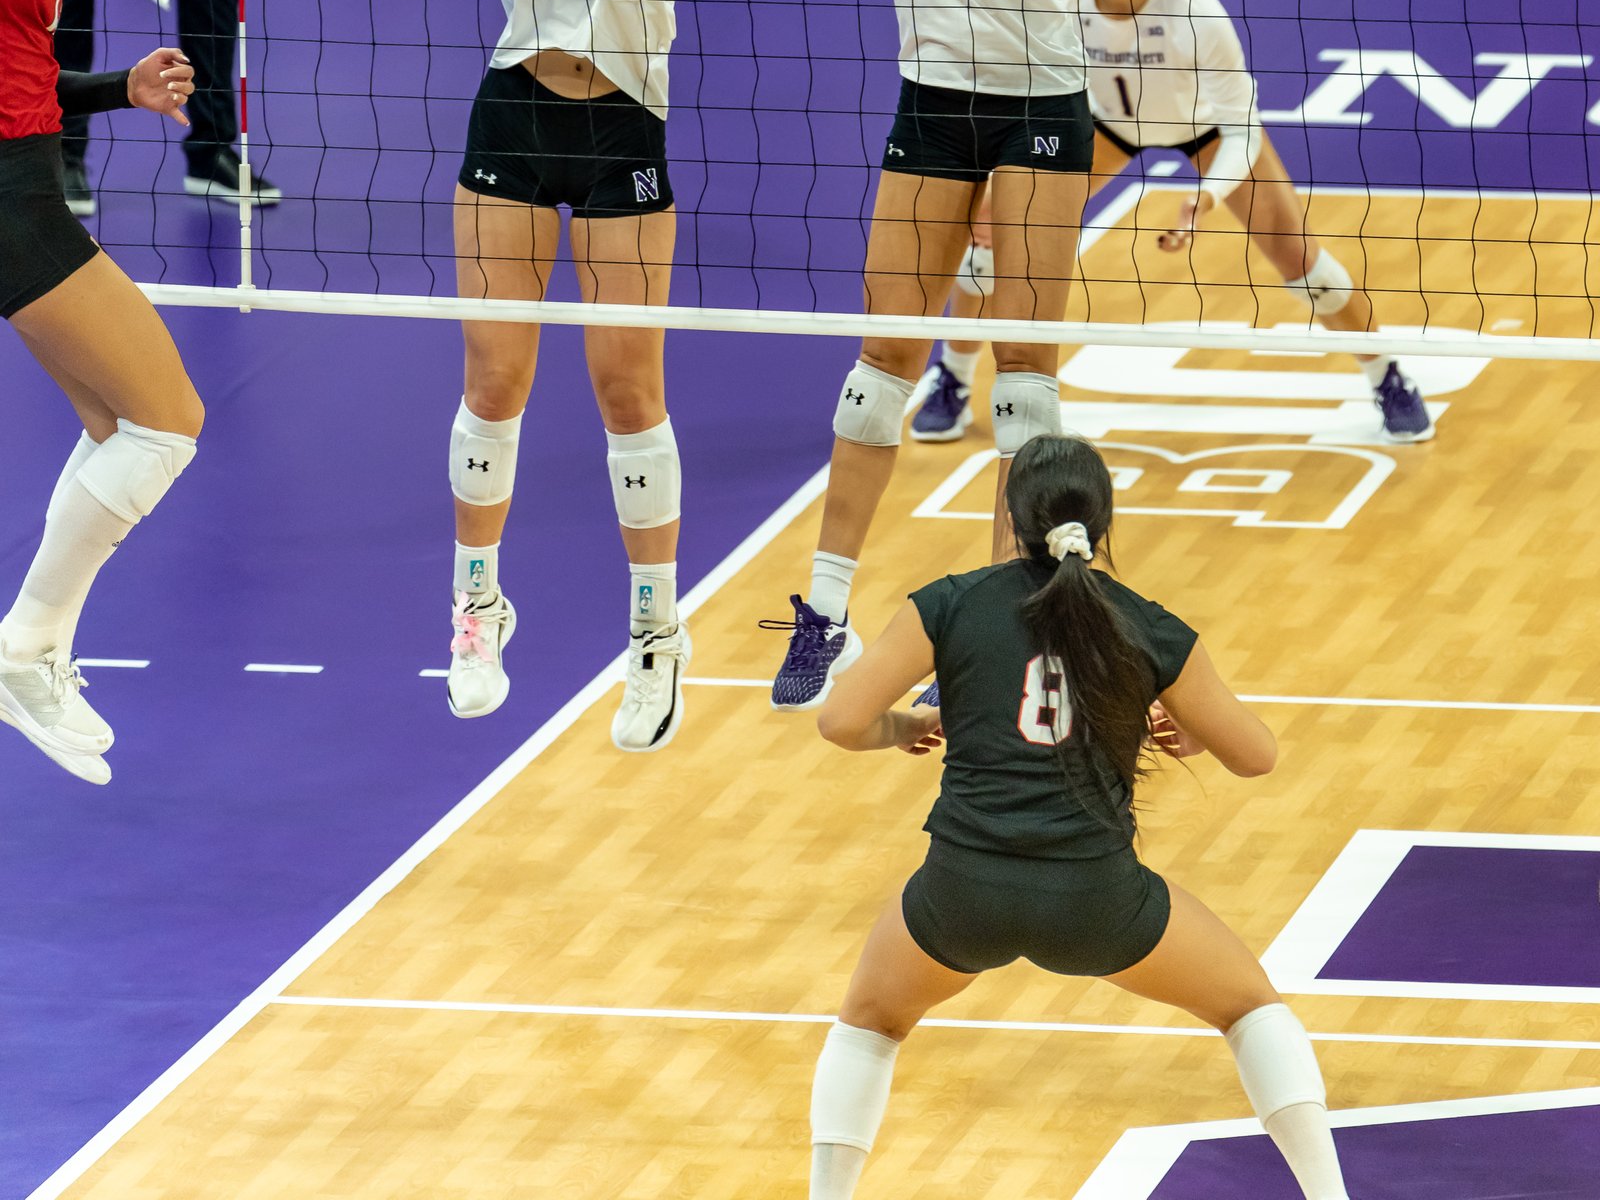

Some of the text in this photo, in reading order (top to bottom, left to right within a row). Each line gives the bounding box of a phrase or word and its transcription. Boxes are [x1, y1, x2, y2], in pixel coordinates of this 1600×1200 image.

[1113, 74, 1135, 118] 1
[632, 168, 659, 202] N
[1017, 653, 1074, 747] 8
